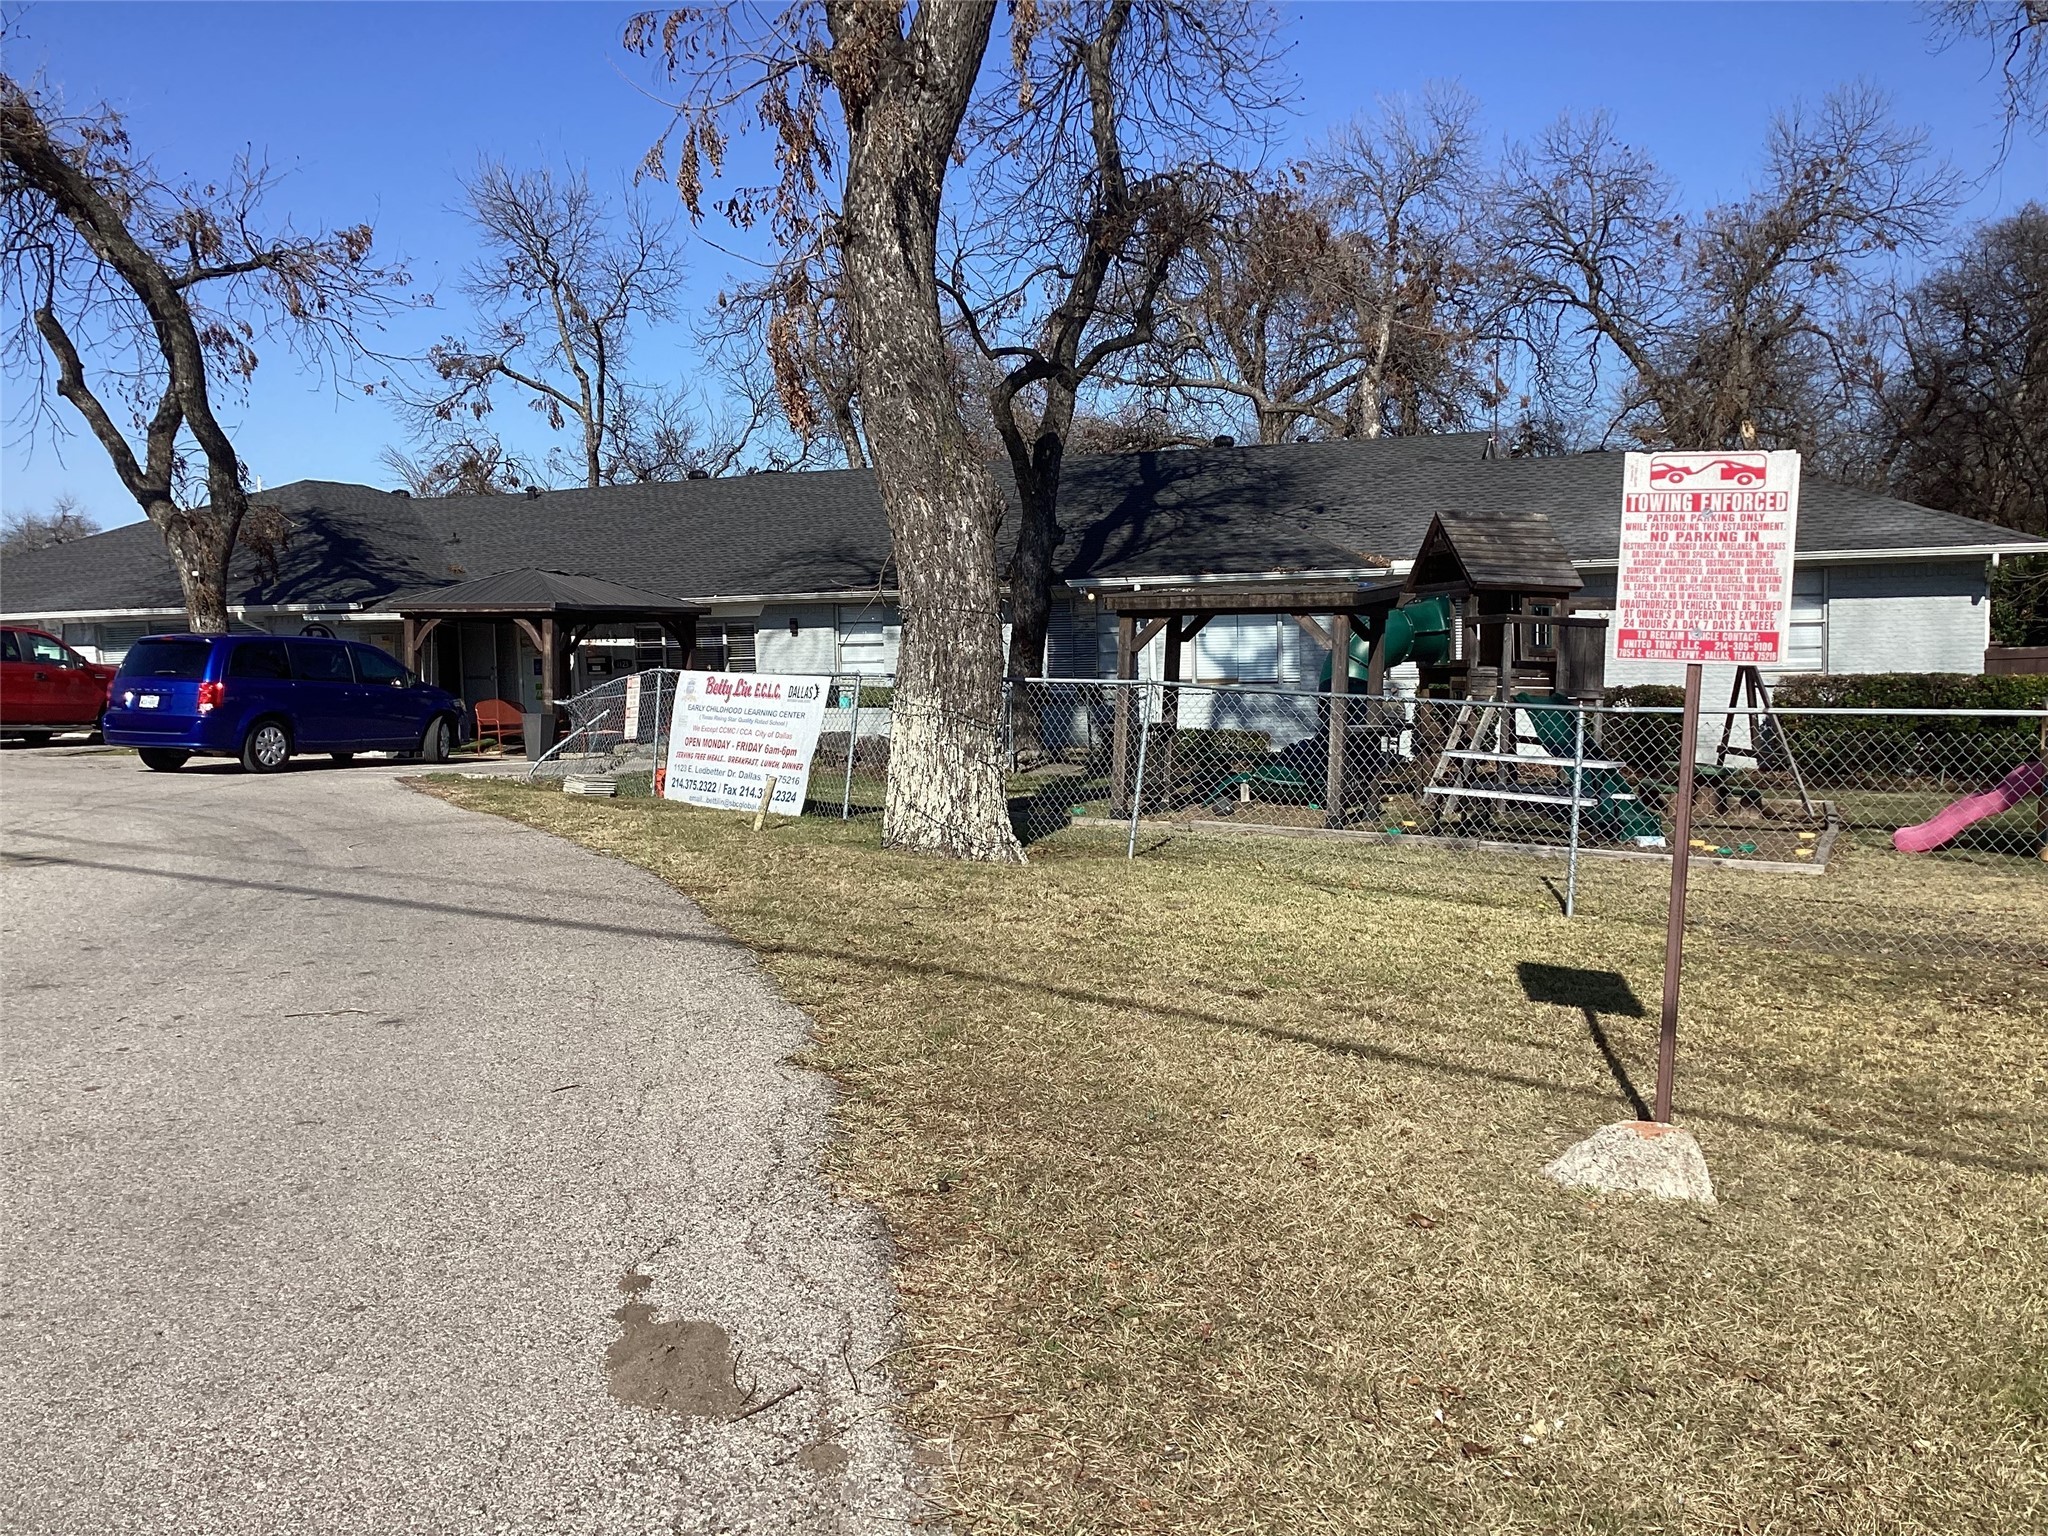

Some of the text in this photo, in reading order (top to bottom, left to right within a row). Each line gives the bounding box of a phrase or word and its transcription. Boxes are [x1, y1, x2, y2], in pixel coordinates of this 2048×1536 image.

[1629, 492, 1786, 512] TOWING ENFORCED
[1647, 514, 1685, 522] PATRON
[1740, 513, 1765, 521] ONLY
[1723, 522, 1786, 530] ESTABLISHMENT.
[1650, 532, 1759, 541] NO PARKING IN
[1620, 600, 1782, 610] UNAUTHORIZED VEHICLES WILL BE TOWED
[1624, 609, 1776, 620] AT OWNER'S OR OPERATOR'S EXPENSE.
[1624, 619, 1776, 630] 24 HOURS A DAY 7 DAYS A WEEK
[1637, 631, 1760, 641] TO RECLAIM VICLE CONTACT:
[1623, 639, 1773, 651] UNITED TOWS L.L.C. 214-309-9100
[1619, 649, 1634, 657] 7054
[1637, 649, 1644, 658] S.
[1646, 650, 1674, 658] CENTRAL
[1734, 652, 1755, 660] TEXAS
[706, 676, 733, 703] Betty
[754, 682, 781, 700] E.C.L.C.
[788, 685, 813, 699] DALLAS
[706, 705, 742, 714] CHILDHOOD
[744, 708, 778, 717] LEARNING
[701, 725, 718, 734] Except
[755, 730, 766, 739] City
[685, 737, 701, 747] OPEN
[702, 738, 731, 749] MONDAY
[736, 741, 763, 753] FRIDAY
[765, 744, 797, 758] 6am-6pm
[727, 756, 759, 766] BREAKFAST,
[760, 760, 779, 769] LUNCH,
[782, 762, 803, 771] DINNER
[675, 764, 687, 772] 1123
[695, 766, 725, 776] Ledbetter
[778, 775, 800, 785] 75216
[672, 777, 716, 792] 214.375.2322
[723, 784, 738, 796] Fax
[739, 786, 797, 803] 214.3.2324
